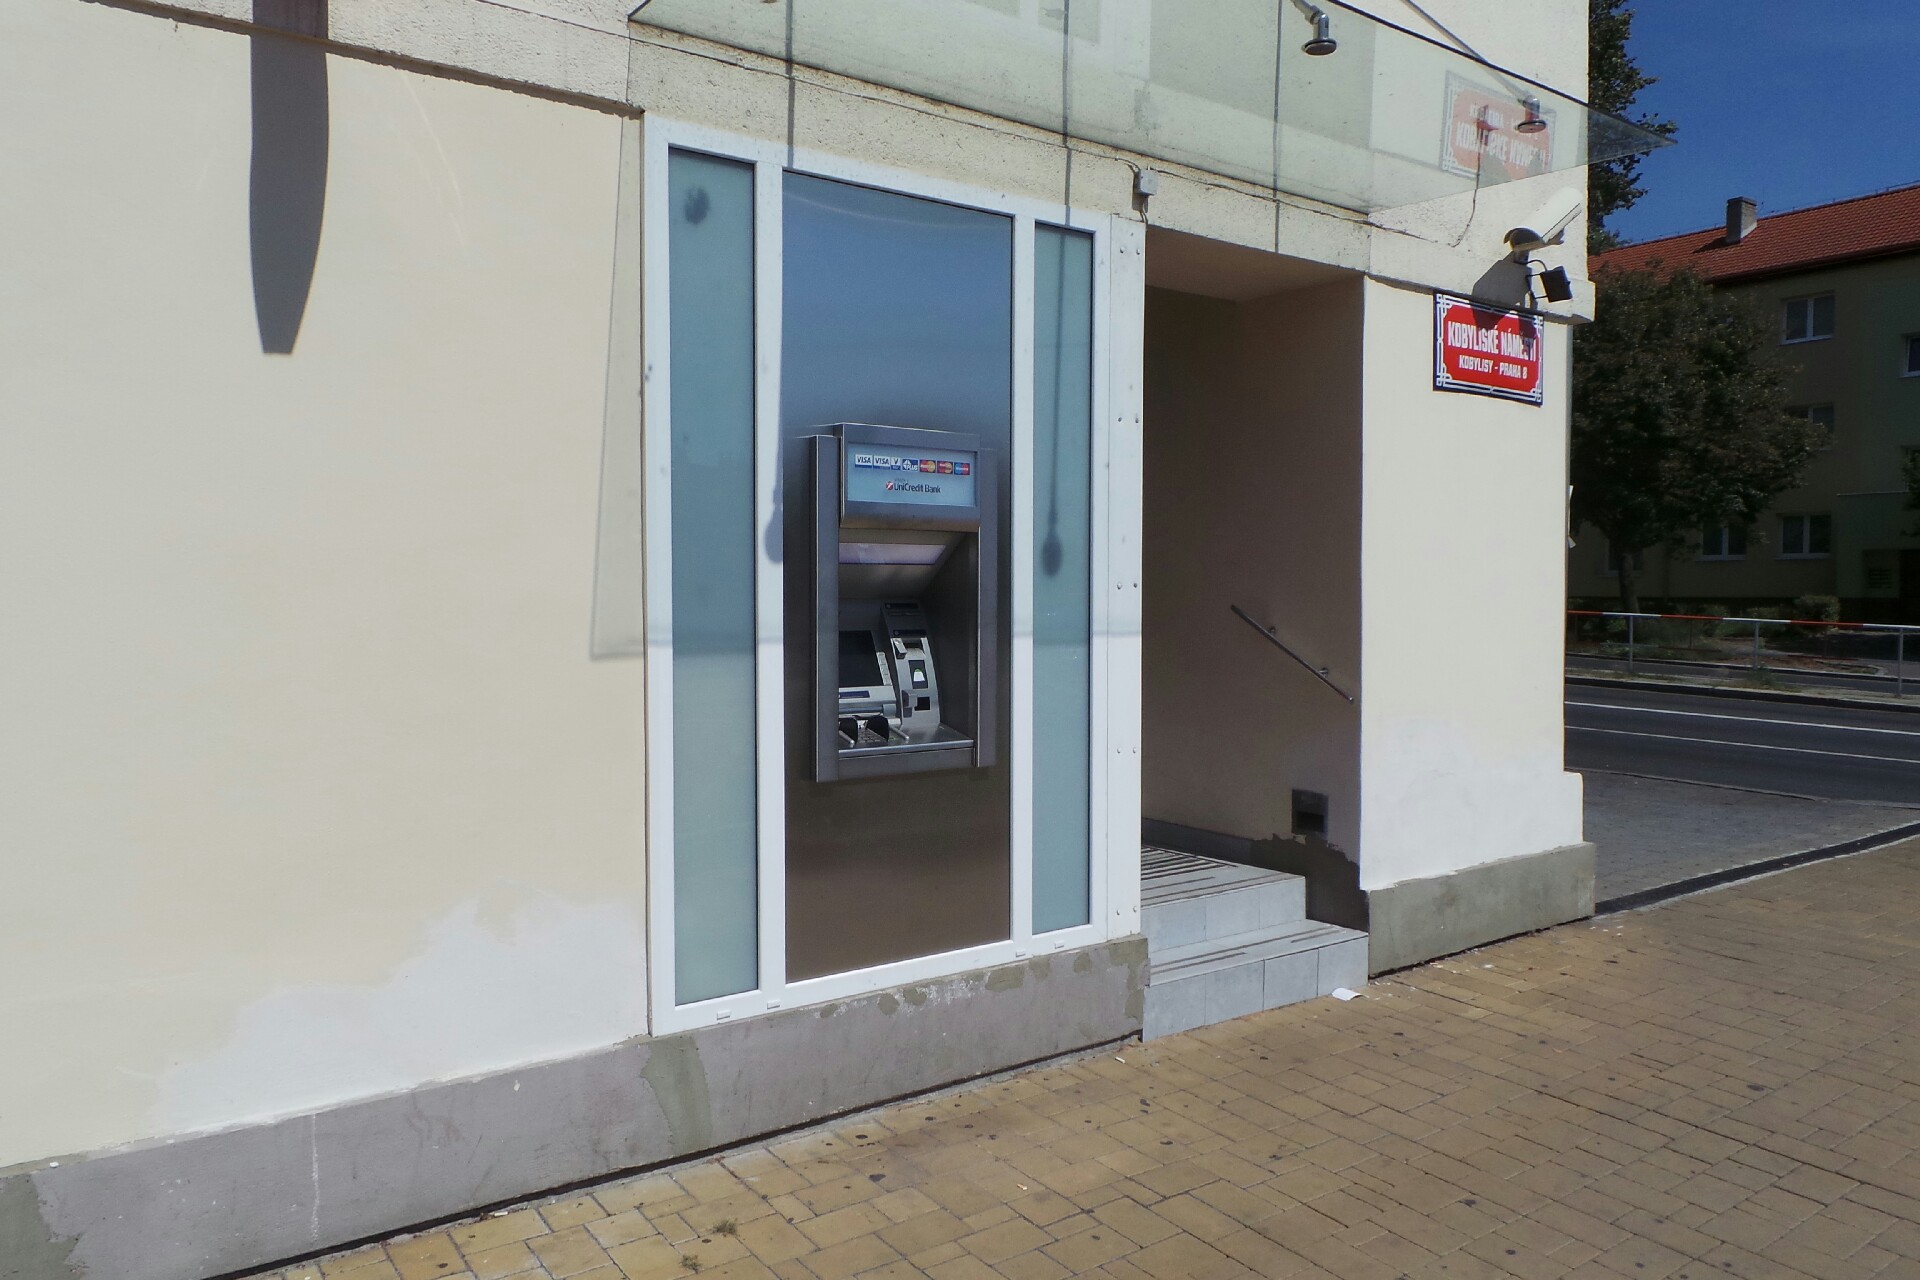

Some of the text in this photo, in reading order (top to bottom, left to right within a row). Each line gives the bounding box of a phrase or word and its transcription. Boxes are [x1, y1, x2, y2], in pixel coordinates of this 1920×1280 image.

[1448, 320, 1499, 354] KOBYLISKÉ
[1459, 354, 1494, 373] KOBYLISY
[1499, 362, 1521, 378] PRAHA
[1522, 366, 1528, 379] 8
[875, 457, 889, 465] VISA
[894, 482, 941, 493] UniCredit Bank
